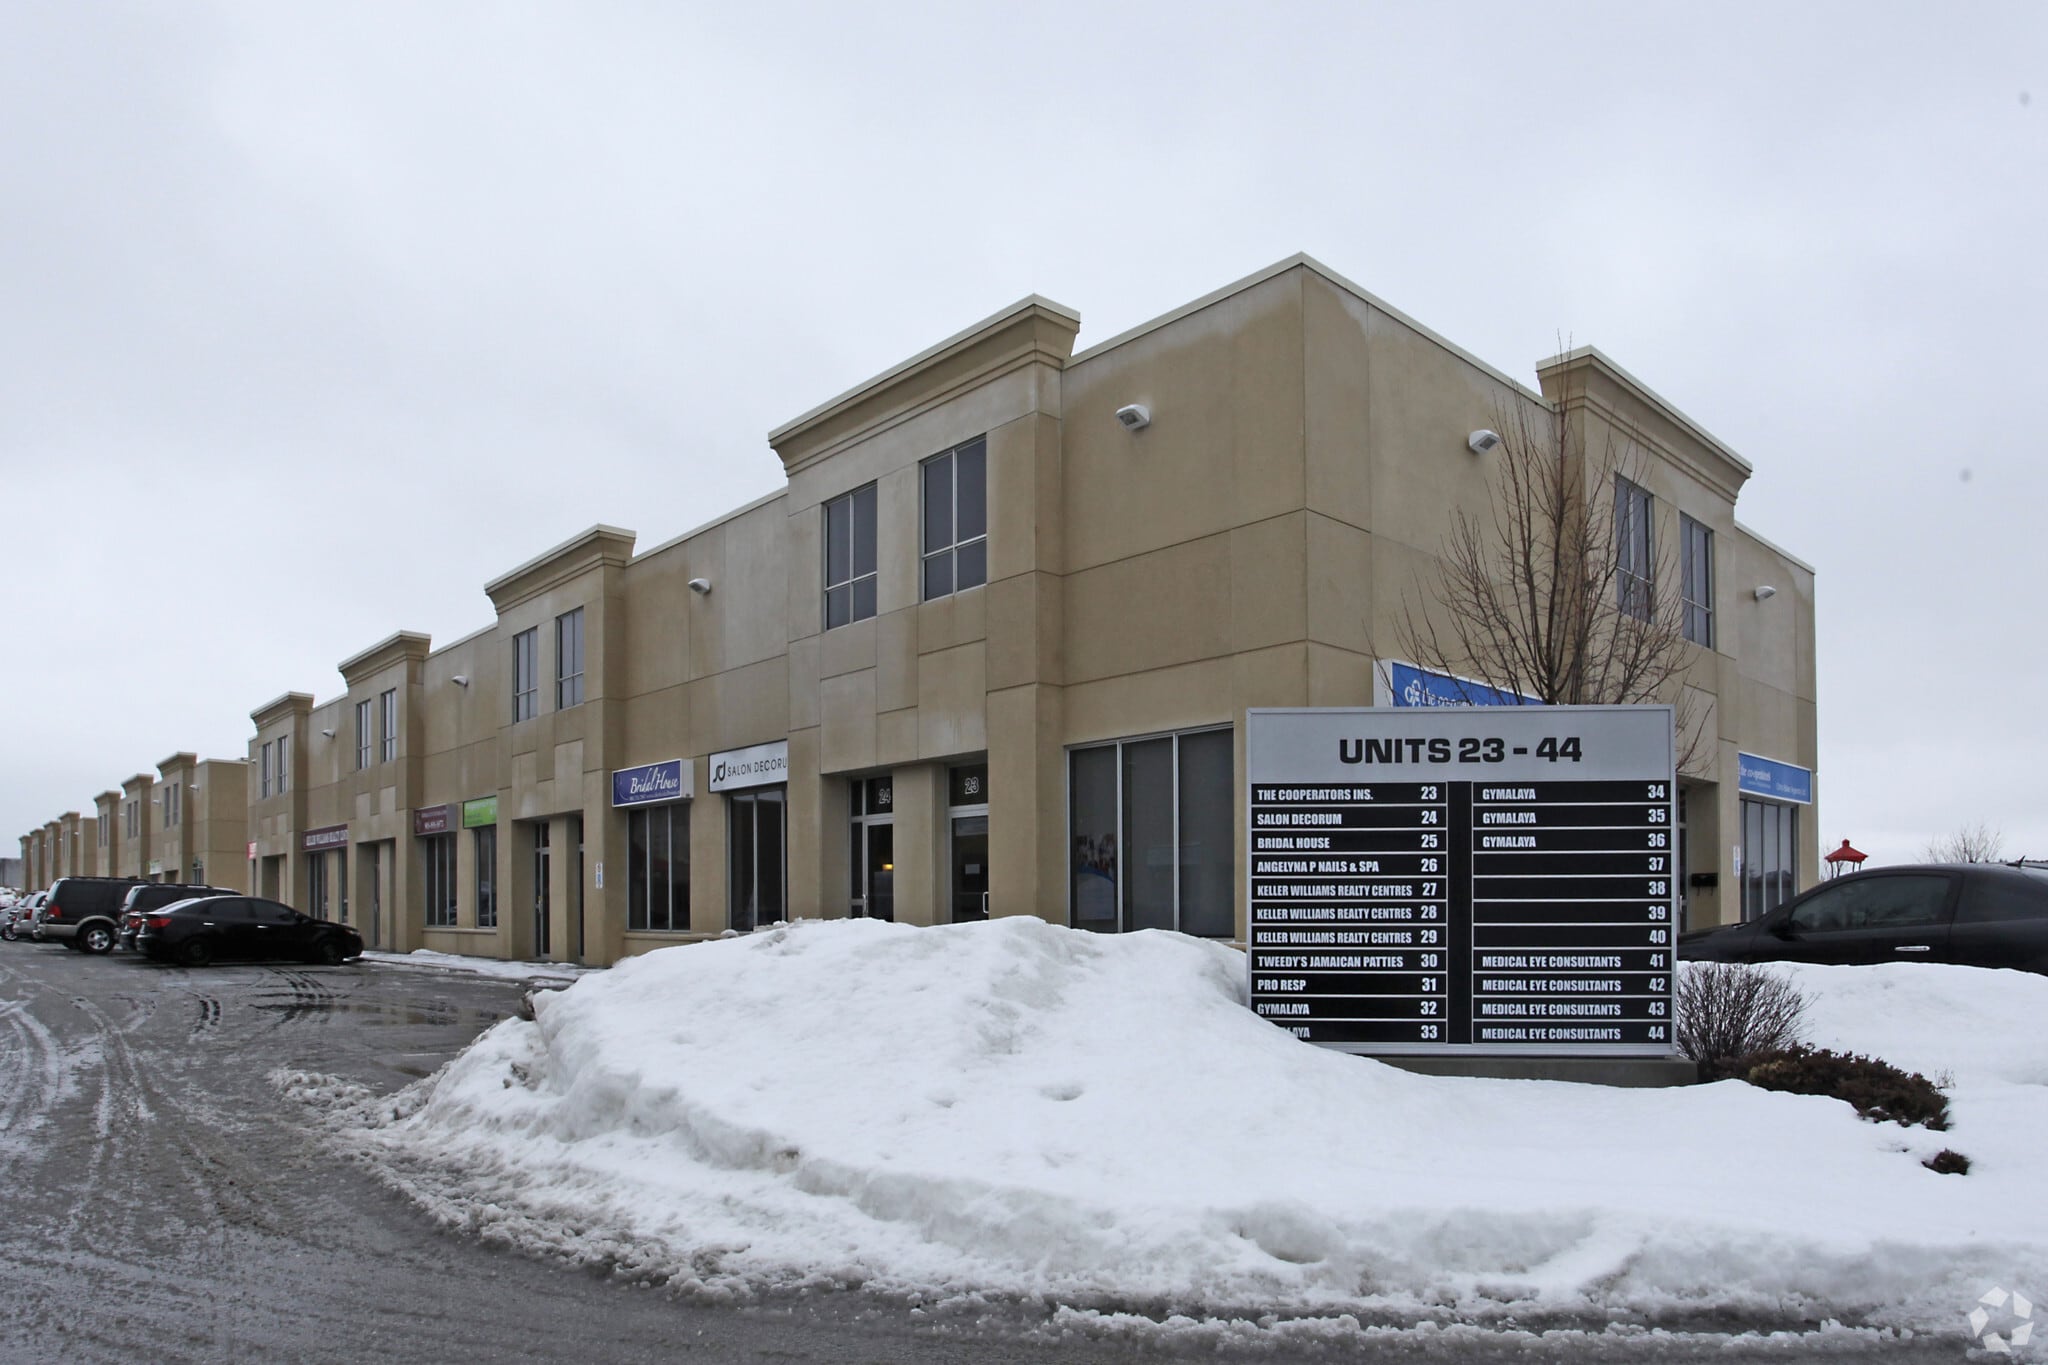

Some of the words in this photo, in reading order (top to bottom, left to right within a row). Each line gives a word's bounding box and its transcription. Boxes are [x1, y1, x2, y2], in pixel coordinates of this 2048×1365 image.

[1339, 738, 1451, 764] UNITS
[1458, 738, 1506, 763] 23
[1512, 747, 1529, 756] -
[1535, 737, 1583, 763] 44
[727, 763, 752, 777] SALON
[754, 757, 787, 773] DECORU
[630, 766, 659, 794] Bridal
[655, 769, 679, 790] House
[964, 776, 980, 795] 23
[878, 788, 891, 804] 24
[1257, 789, 1277, 801] THE
[1278, 788, 1352, 801] COOPERATORS
[1352, 788, 1374, 801] INS.
[1420, 785, 1438, 800] 23
[1482, 788, 1537, 801] GYMALAYA
[1647, 784, 1665, 799] 34
[1257, 813, 1290, 826] SALON
[1291, 813, 1342, 825] DECORUM
[1421, 810, 1438, 825] 24
[1482, 812, 1537, 825] GYMALAYA
[1648, 808, 1666, 823] 35
[1257, 837, 1295, 849] BRIDAL
[1296, 837, 1330, 849] HOUSE
[1420, 833, 1438, 848] 25
[1482, 836, 1537, 848] GYMALAYA
[1647, 832, 1666, 848] 36
[1256, 861, 1308, 873] ANGELYNA
[1309, 861, 1317, 873] P
[1318, 860, 1348, 873] NAILS
[1349, 862, 1358, 873] &
[1358, 860, 1380, 873] SPA
[1420, 857, 1438, 873] 26
[1648, 856, 1664, 872] 37
[1257, 885, 1289, 897] KELLER
[1290, 884, 1337, 897] WILLIAMS
[1337, 884, 1371, 897] REALTY
[1371, 884, 1413, 897] CENTRES
[1422, 882, 1437, 897] 27
[1648, 880, 1666, 896] 38
[1256, 908, 1289, 920] KELLER
[1289, 908, 1336, 920] WILLIAMS
[1337, 907, 1370, 920] REALTY
[1370, 907, 1412, 920] CENTRES
[1420, 904, 1438, 919] 28
[1648, 905, 1666, 920] 39
[1256, 931, 1289, 944] KELLER
[1289, 931, 1336, 944] WILLIAMS
[1337, 932, 1370, 944] REALTY
[1370, 932, 1412, 944] CENTRES
[1420, 929, 1438, 944] 29
[1648, 929, 1666, 944] 40
[1257, 955, 1308, 968] TWEEDY'S
[1309, 956, 1361, 968] JAMAICAN
[1362, 955, 1404, 968] PATTIES
[1420, 953, 1438, 968] 30
[1482, 955, 1528, 968] MEDICAL
[1529, 956, 1547, 968] EYE
[1548, 955, 1622, 968] CONSULTANTS
[1649, 953, 1664, 968] 41
[1257, 979, 1279, 991] PRO
[1280, 979, 1307, 991] RESP
[1421, 977, 1437, 992] 31
[1482, 979, 1528, 991] MEDICAL
[1529, 979, 1548, 992] EYE
[1548, 979, 1622, 992] CONSULTANTS
[1648, 977, 1665, 992] 42
[1256, 1002, 1310, 1016] GYMALAYA
[1420, 1000, 1437, 1015] 32
[1481, 1003, 1528, 1016] MEDICAL
[1529, 1003, 1547, 1016] EYE
[1548, 1003, 1621, 1016] CONSULTANTS
[1647, 1001, 1665, 1016] 43
[1420, 1024, 1438, 1039] 33
[1482, 1027, 1528, 1040] MEDICAL
[1529, 1028, 1547, 1040] EYE
[1548, 1028, 1621, 1040] CONSULTANTS
[1648, 1025, 1665, 1040] 44
